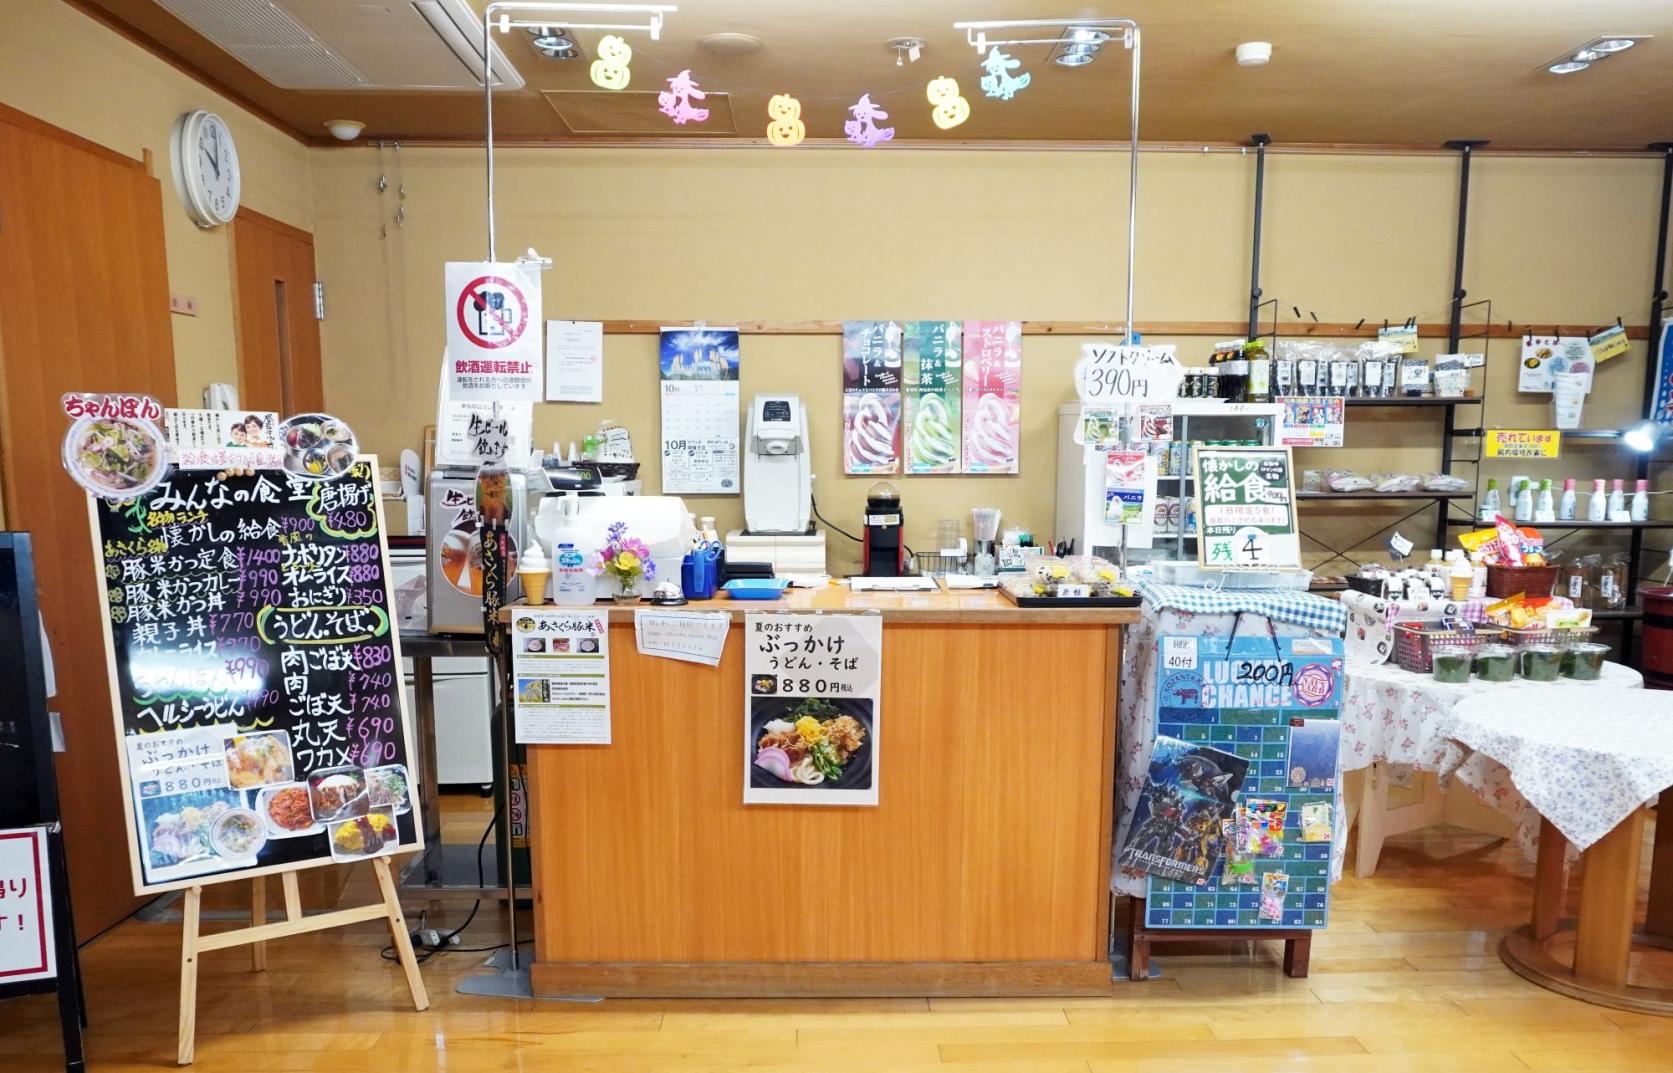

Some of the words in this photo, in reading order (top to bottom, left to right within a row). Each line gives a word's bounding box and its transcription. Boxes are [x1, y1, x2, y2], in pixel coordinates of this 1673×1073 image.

[455, 360, 533, 374] 飲酒運転禁止
[860, 328, 872, 387] チョコレート
[980, 327, 993, 387] ストロベリー
[920, 358, 933, 385] 抹茶
[1089, 368, 1148, 398] 390円
[65, 395, 160, 419] ちゃんぽん
[468, 413, 508, 437] 生ビール
[665, 440, 686, 451] 10月
[1202, 458, 1259, 473] 懐かしの
[150, 473, 314, 511] みんなの食堂
[317, 482, 372, 514] 唐揚げ
[1204, 472, 1272, 503] 給食
[161, 516, 282, 548] 懐かしの給食
[327, 510, 367, 528] ¥480
[281, 543, 349, 568] ナポリタン
[1212, 541, 1233, 560] 残
[1242, 538, 1264, 560] 4
[122, 546, 240, 582] 豚米かつ定食
[281, 565, 354, 586] オムライス
[125, 572, 241, 604] 豚米かつカレー
[288, 585, 347, 607] おにぎり
[126, 592, 226, 623] 豚米かつ丼
[236, 588, 282, 608] ¥990
[132, 615, 208, 646] 親子丼
[208, 611, 254, 635] ¥770
[755, 622, 813, 632] 夏のおすすめ
[760, 635, 845, 654] ぶっかけ
[281, 645, 361, 675] 肉ごぼ天
[353, 644, 391, 671] ¥830
[770, 656, 859, 670] うどん・そば
[283, 671, 308, 696] 肉
[347, 671, 391, 691] ¥740
[1202, 684, 1293, 708] CHANCE
[136, 695, 245, 727] ヘルシーうどん
[289, 692, 353, 716] ごぼ天
[349, 693, 391, 712] ¥740
[291, 719, 347, 748] 丸天
[346, 716, 394, 742] ¥690
[296, 746, 352, 772] ワカメ
[1125, 847, 1206, 876] TRANSFORMERS
